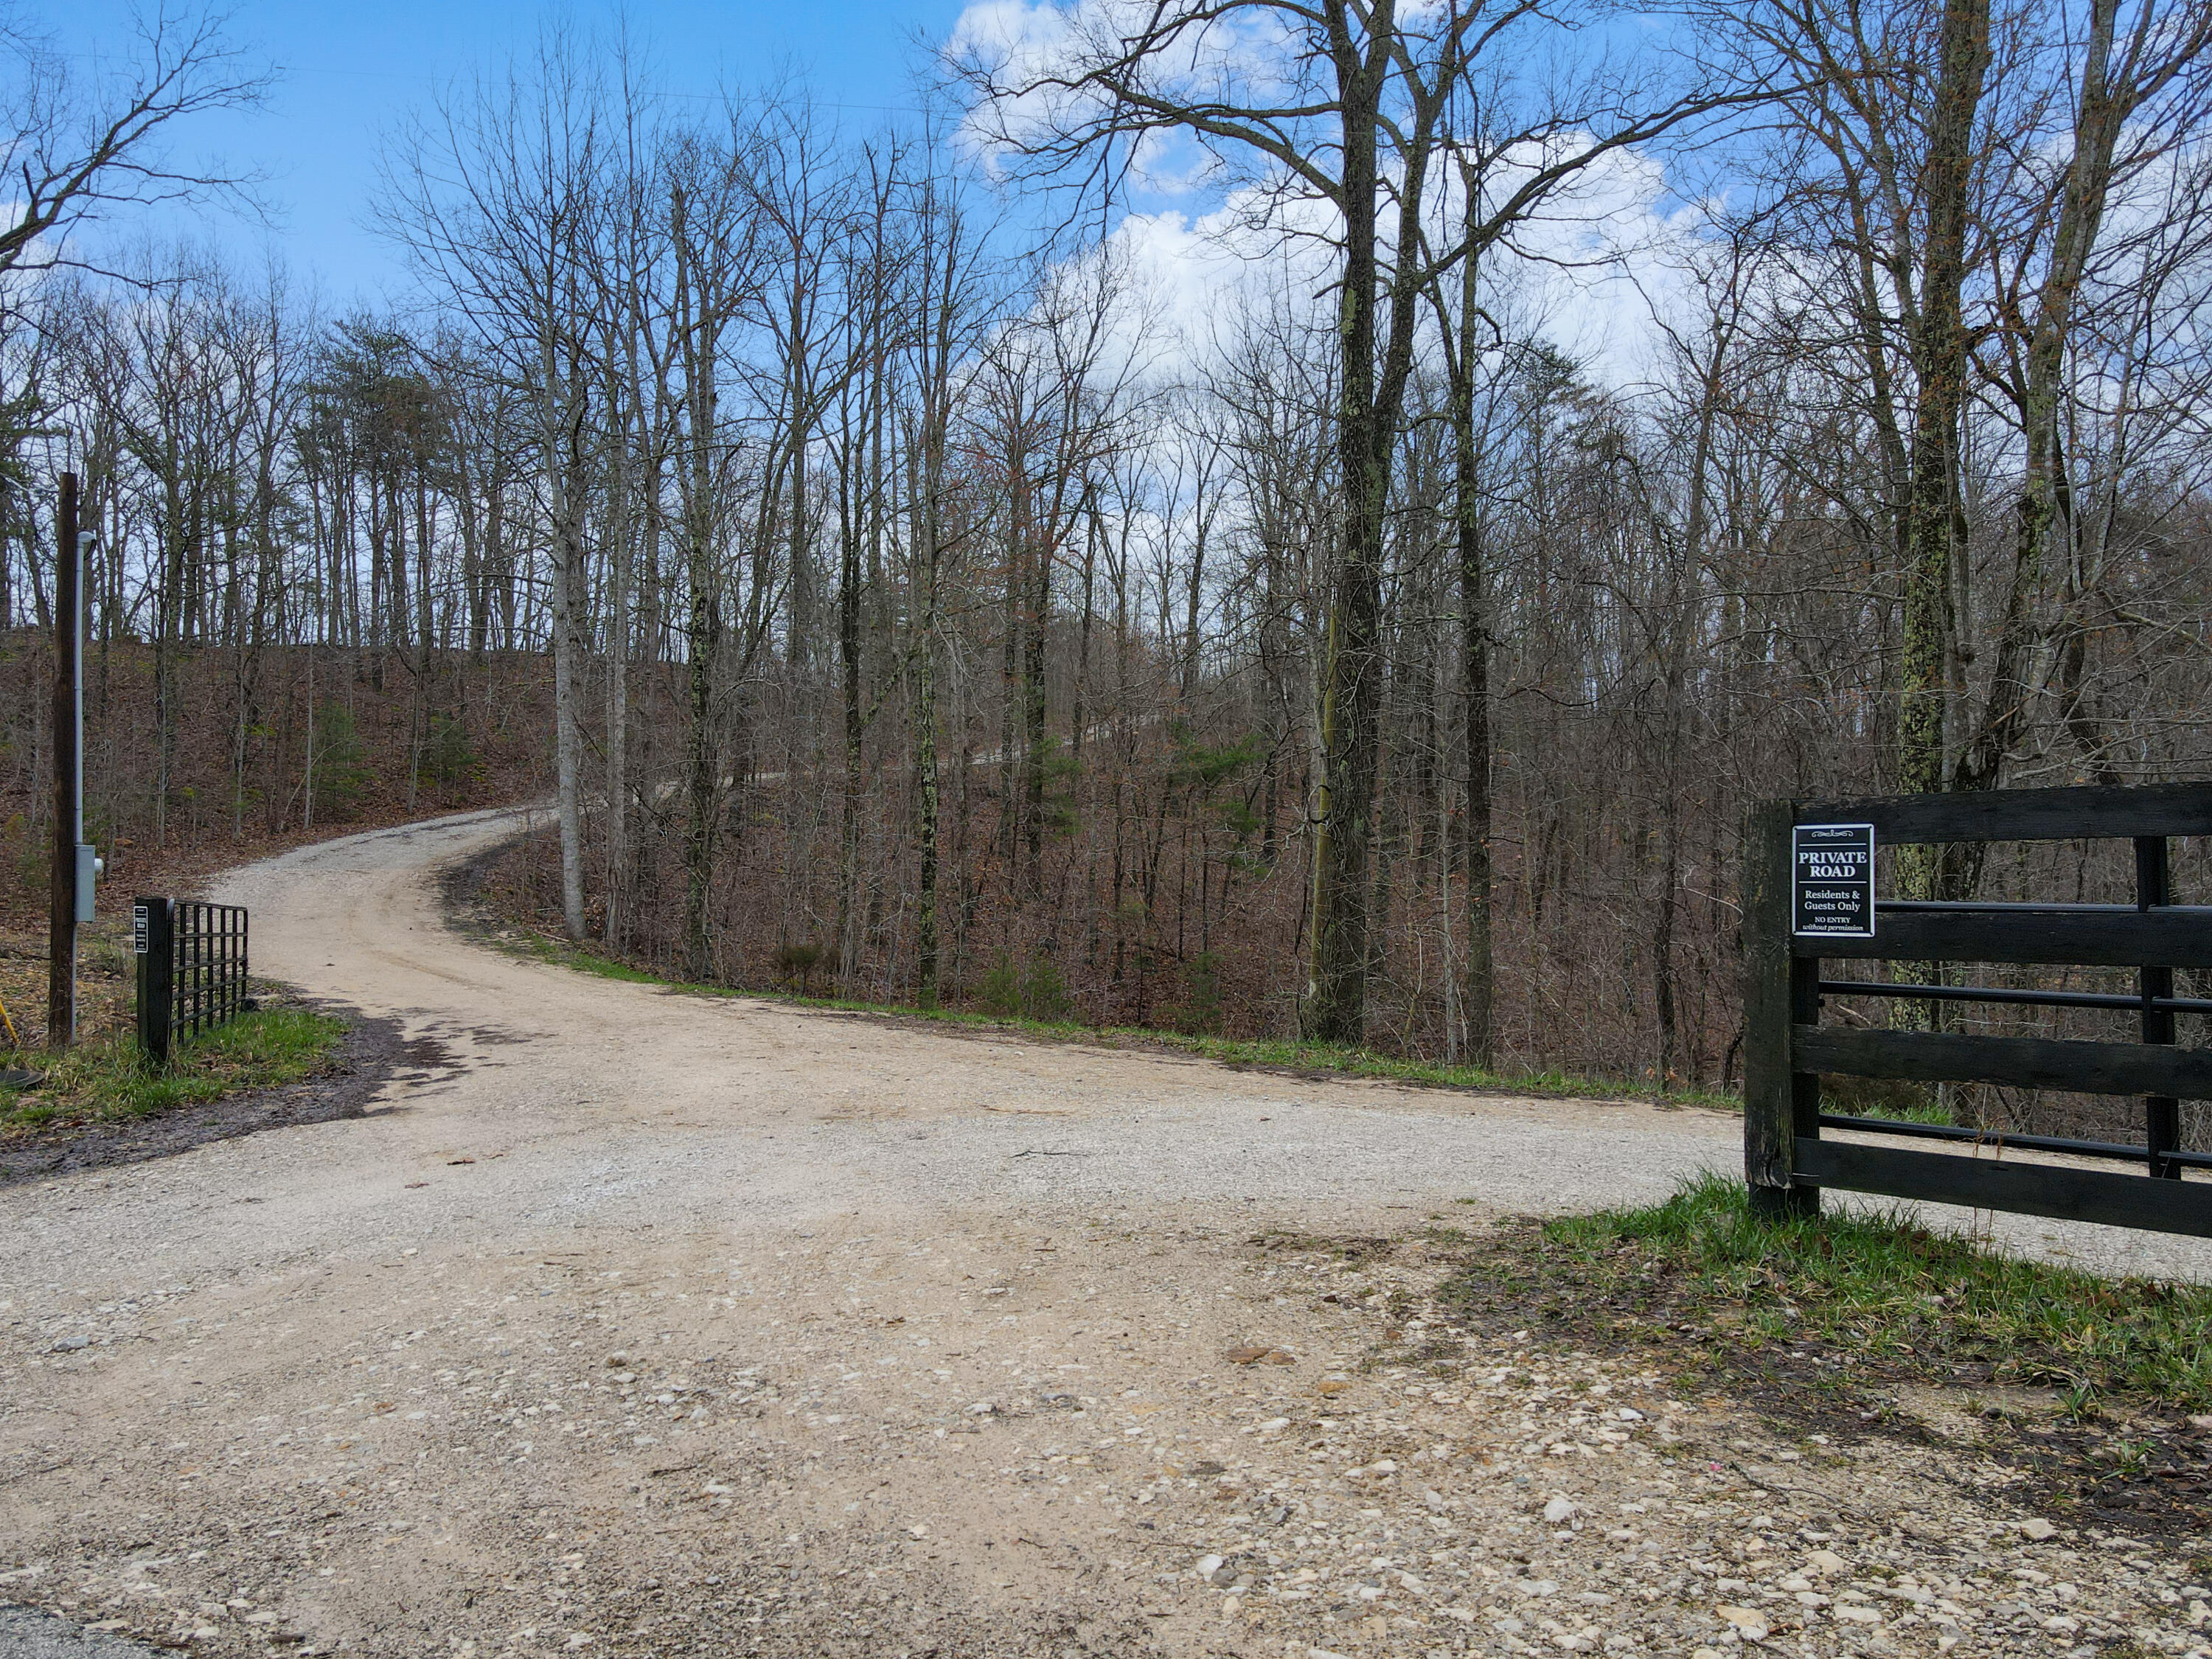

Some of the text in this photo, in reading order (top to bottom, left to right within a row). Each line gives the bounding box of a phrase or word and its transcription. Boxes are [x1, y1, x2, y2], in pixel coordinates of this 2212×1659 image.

[1798, 852, 1867, 863] PRIVATE
[1809, 865, 1856, 877] ROAD
[1805, 890, 1860, 899] Residents &
[1804, 901, 1861, 912] Guests Only
